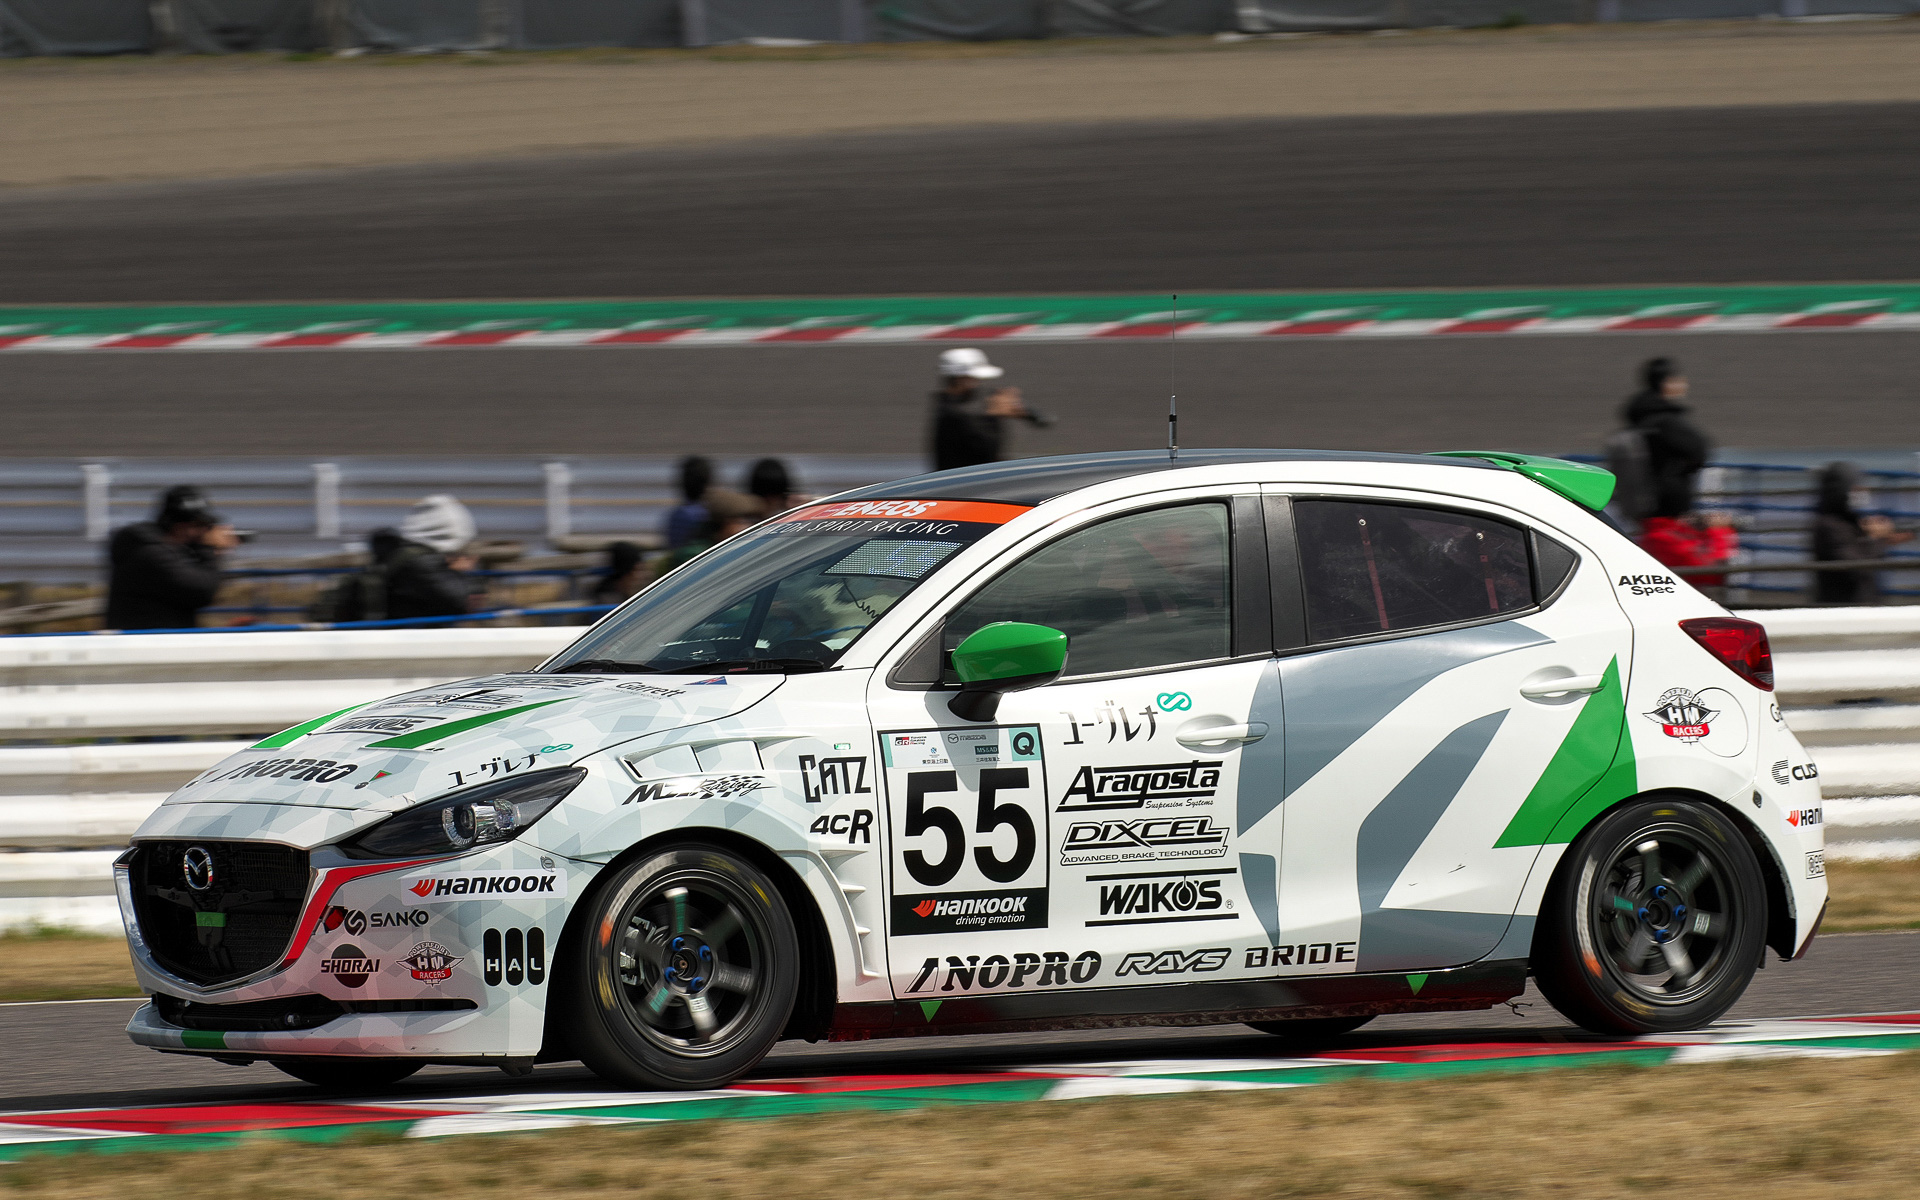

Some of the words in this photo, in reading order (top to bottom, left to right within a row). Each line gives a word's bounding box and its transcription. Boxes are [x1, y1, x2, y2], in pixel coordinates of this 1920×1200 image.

[832, 501, 937, 517] ENEOS
[807, 521, 872, 533] SPIRIT
[868, 521, 959, 535] RACING
[1618, 575, 1677, 586] AKIBA
[1631, 586, 1675, 596] Spec
[615, 682, 686, 697] Garrett
[1059, 700, 1158, 745] ユーグレナ
[1672, 726, 1704, 736] RACERS
[1013, 732, 1035, 756] Q
[448, 752, 540, 790] ユーグレナ
[1058, 760, 1220, 807] Aragosta
[1145, 801, 1183, 810] Suspension
[1186, 799, 1214, 808] Systems
[810, 809, 873, 844] 4CR
[903, 767, 1037, 887] 55
[1066, 819, 1223, 847] DIXCEL
[1063, 854, 1119, 864] ADVANCED
[1121, 852, 1155, 860] BRAKE
[1158, 848, 1224, 858] TECHNOLOGY
[435, 876, 557, 896] HANKOOK
[1100, 880, 1223, 915] WAKO'S
[934, 897, 1028, 916] HANKOOK
[370, 909, 429, 927] SANKO
[955, 915, 986, 926] driving
[988, 914, 1026, 924] emotion
[416, 955, 445, 970] HM
[1116, 948, 1232, 976] RAYS
[1244, 942, 1357, 969] BRIDE
[321, 959, 380, 973] SHORAI
[486, 957, 542, 972] HAL
[419, 971, 446, 979] RACERS
